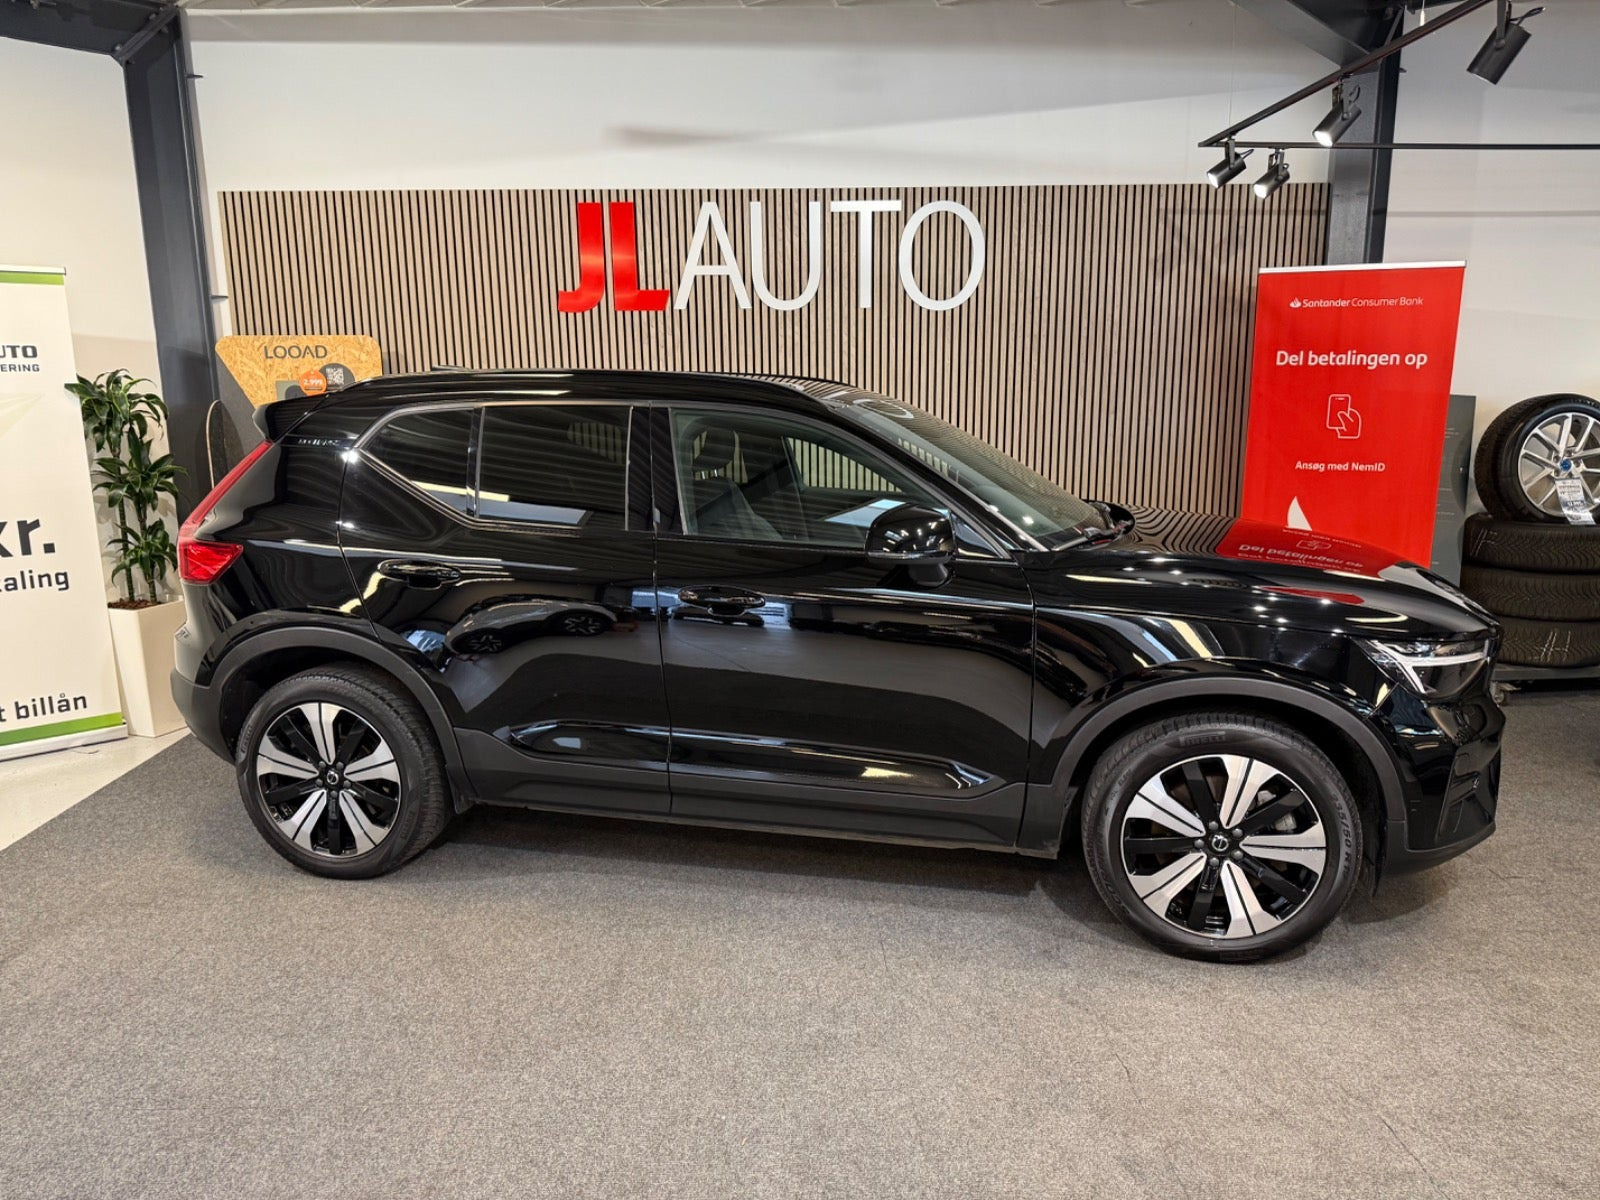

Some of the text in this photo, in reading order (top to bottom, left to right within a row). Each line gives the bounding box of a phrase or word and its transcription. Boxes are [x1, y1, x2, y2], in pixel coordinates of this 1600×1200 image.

[673, 199, 986, 311] AUTO
[1302, 296, 1424, 308] Santander Consumer Bank
[264, 345, 328, 359] LOOAD
[1275, 350, 1427, 370] Del betalingen op
[0, 364, 40, 372] ERING
[1295, 460, 1386, 473] Ansøg med NemID
[0, 569, 70, 592] aling
[14, 692, 88, 720] billån
